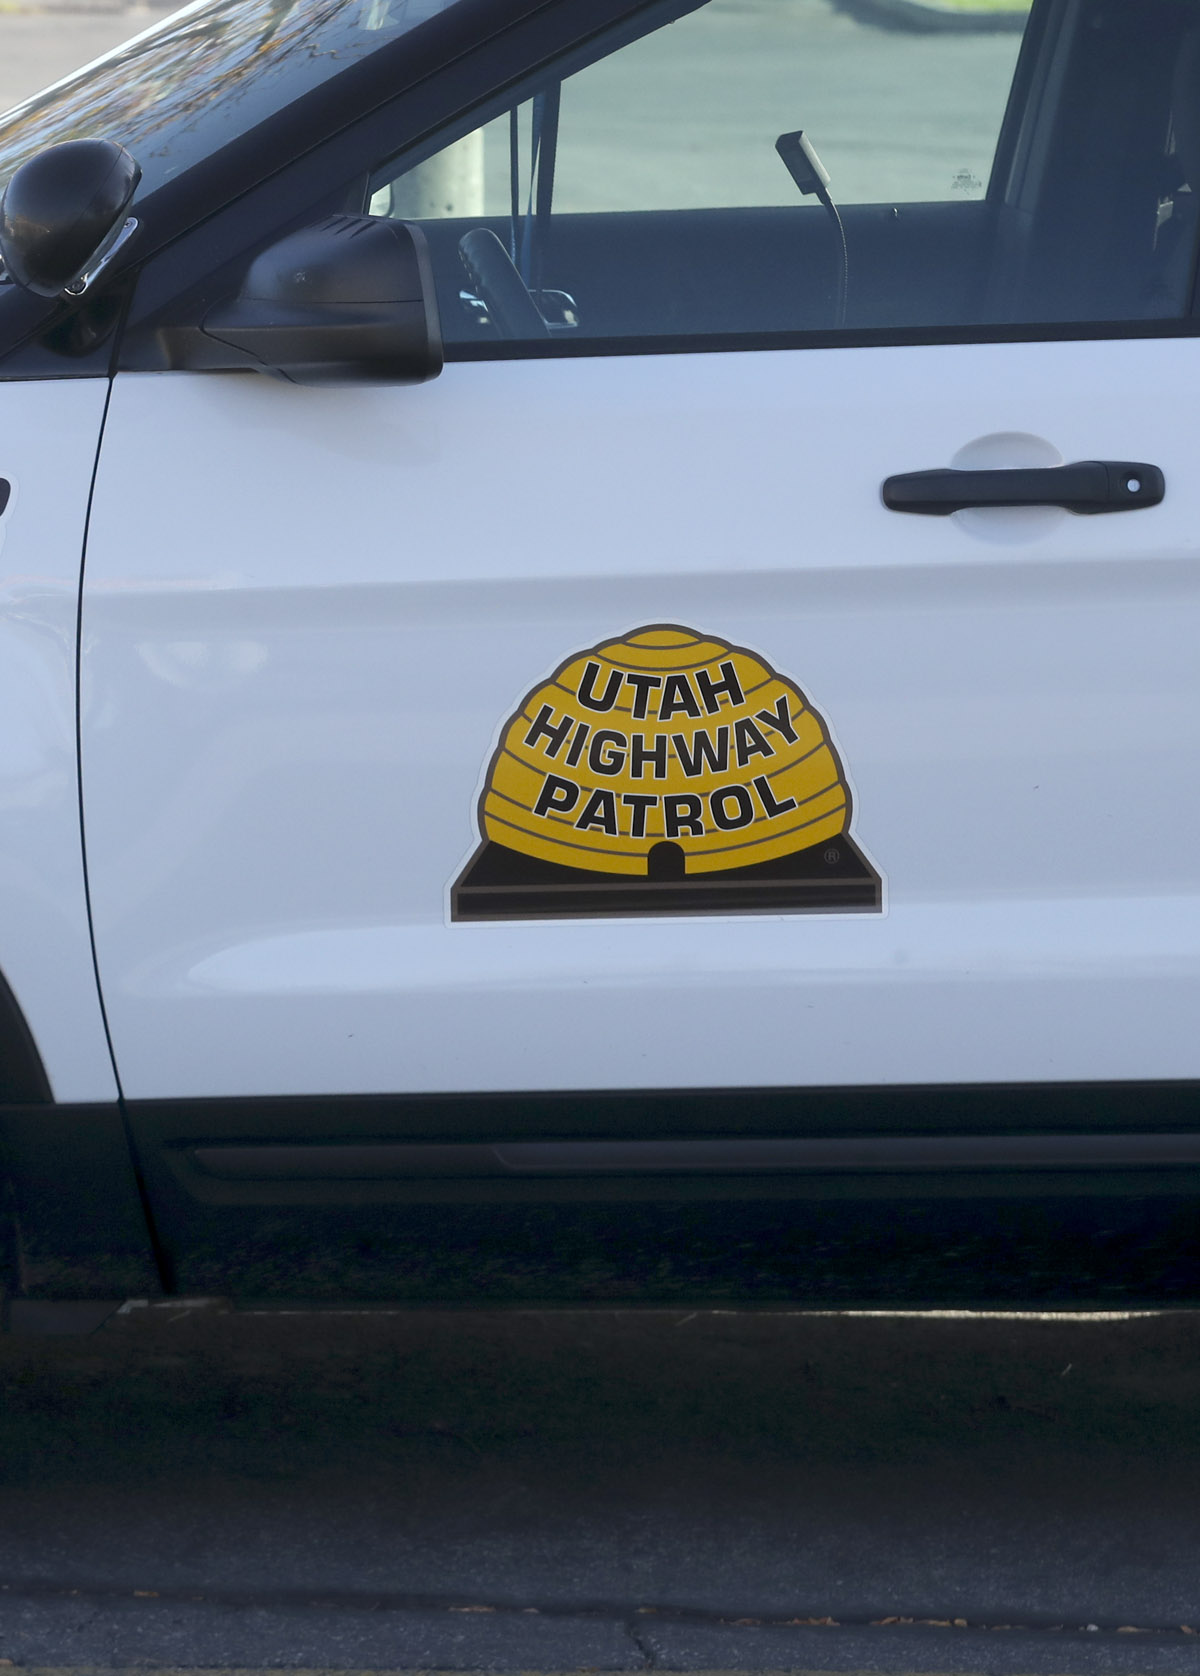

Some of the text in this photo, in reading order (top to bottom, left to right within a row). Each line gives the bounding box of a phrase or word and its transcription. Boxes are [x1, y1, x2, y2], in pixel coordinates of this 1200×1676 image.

[576, 660, 745, 721] UTAH
[523, 694, 800, 779] HIGHWAY
[533, 772, 798, 839] PATROL
